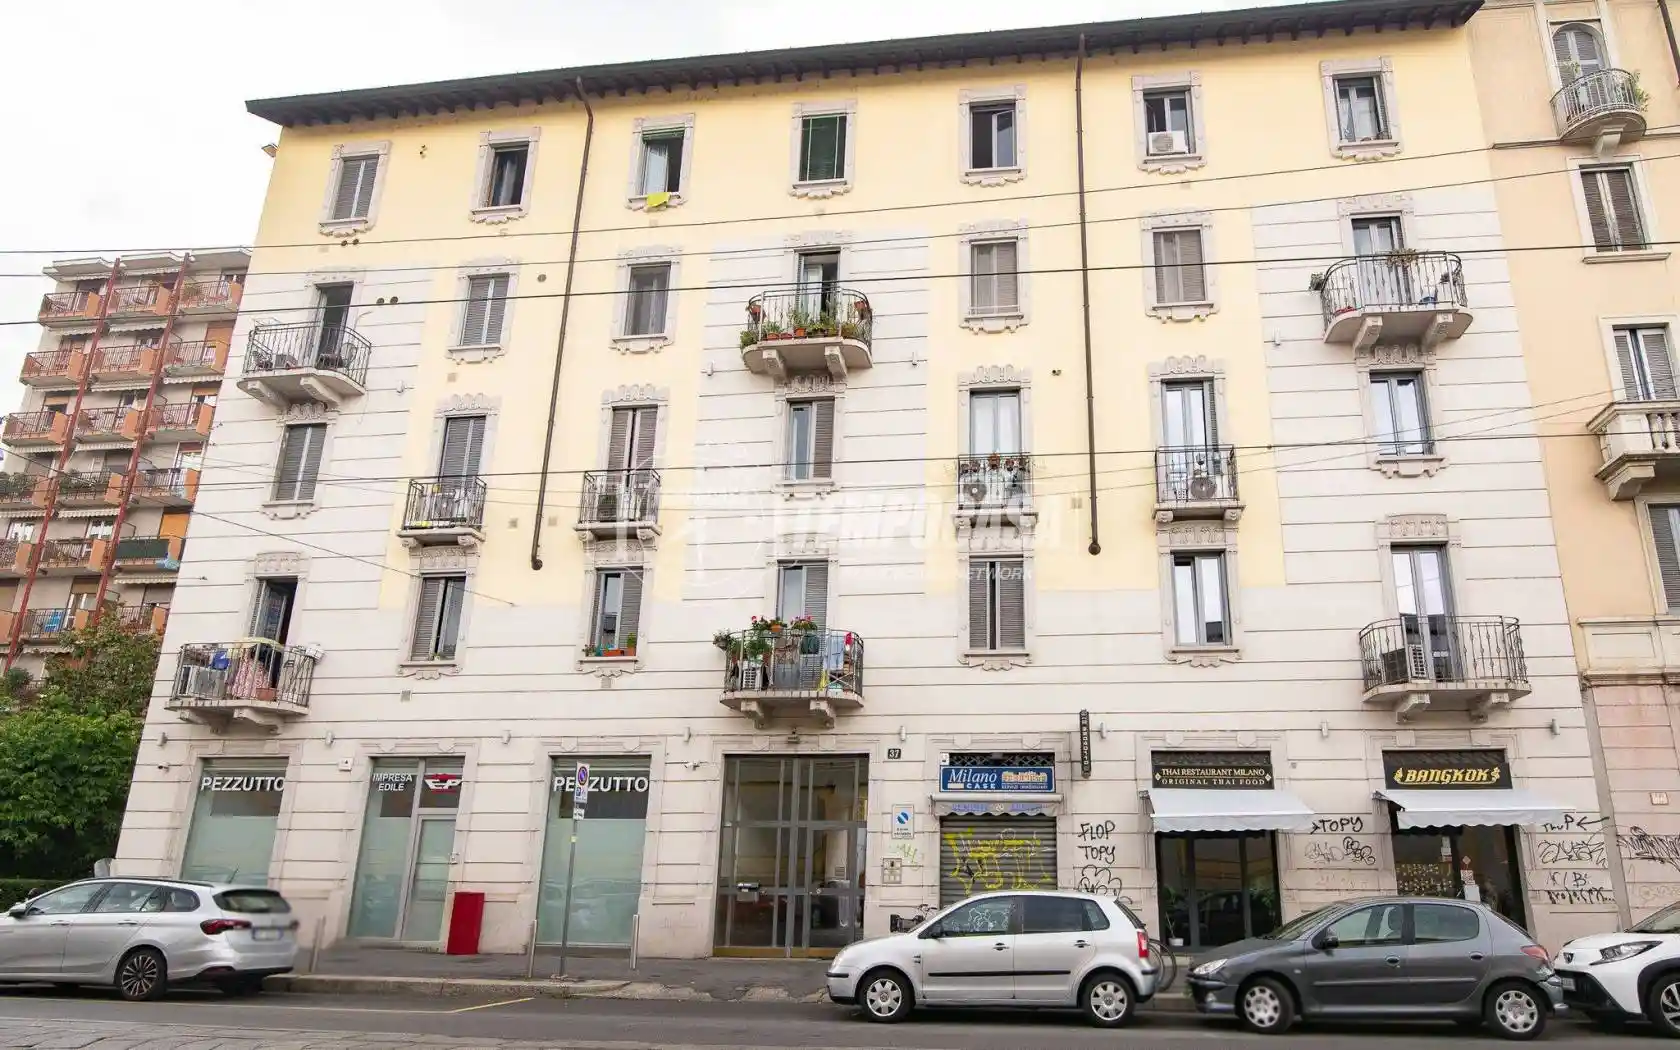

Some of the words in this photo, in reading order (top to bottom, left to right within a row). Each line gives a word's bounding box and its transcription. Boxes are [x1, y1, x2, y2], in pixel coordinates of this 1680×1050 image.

[889, 749, 900, 758] 37
[372, 773, 413, 783] IMPRESA
[948, 768, 997, 783] Milano
[1162, 768, 1180, 776] THAI
[1181, 768, 1232, 776] RESTAURANT
[1233, 768, 1265, 776] MILANO
[1406, 769, 1489, 784] BANGKOK
[200, 776, 285, 792] PEZZUTTO
[378, 783, 404, 792] EDILE
[553, 776, 649, 792] PEZUTTO
[1078, 820, 1115, 841] FLOP
[1319, 816, 1363, 832] TOPY
